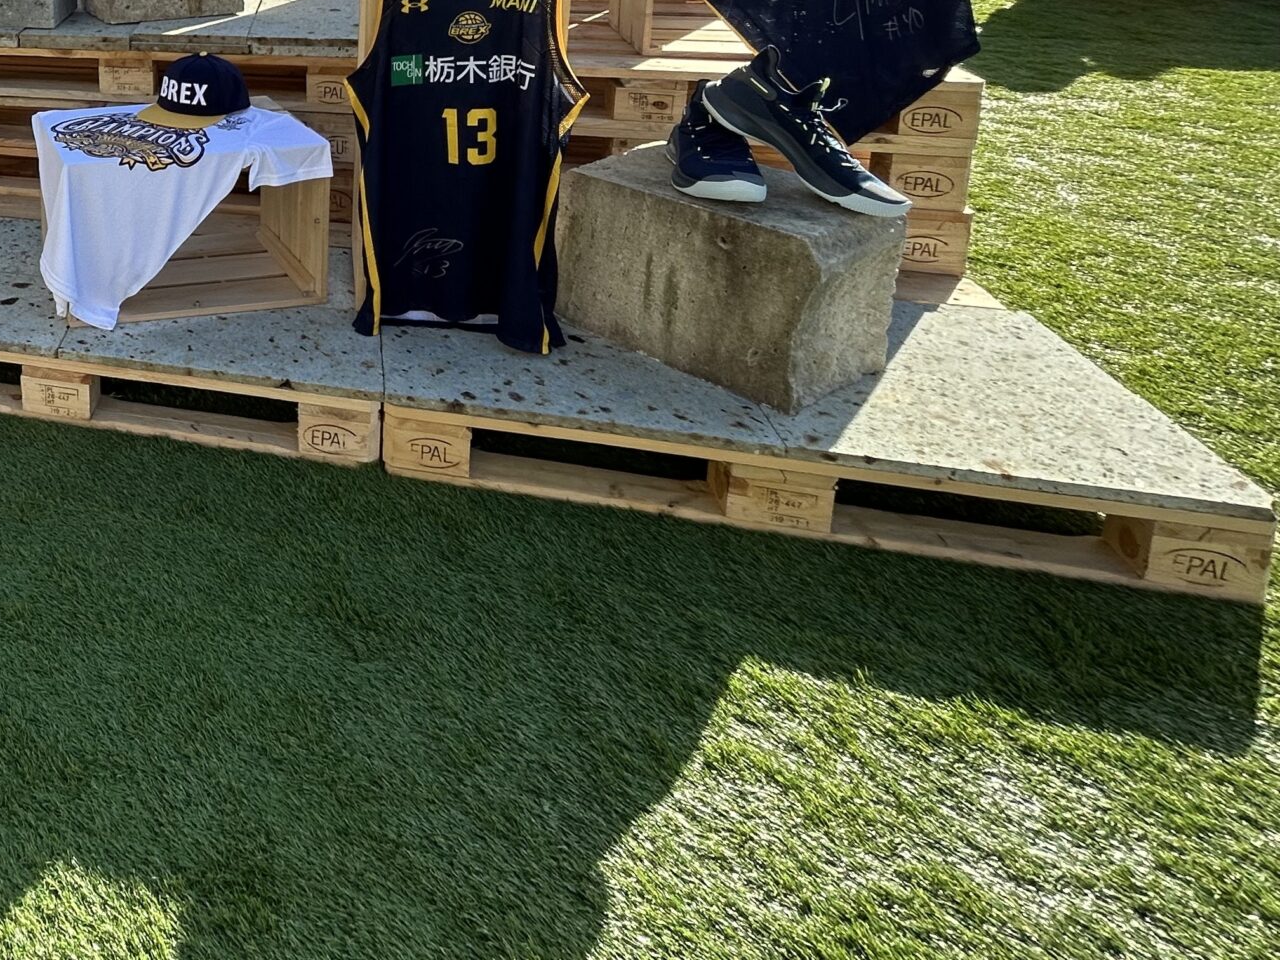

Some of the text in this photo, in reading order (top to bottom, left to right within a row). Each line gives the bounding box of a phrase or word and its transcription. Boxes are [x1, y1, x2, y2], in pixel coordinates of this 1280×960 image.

[424, 54, 536, 91] 栃木銀行
[160, 75, 208, 107] BREX
[910, 112, 952, 129] EPAL
[53, 116, 207, 166] CHAMPIONS
[441, 108, 497, 166] 13
[903, 175, 943, 193] EPAL
[902, 240, 939, 258] EPAL
